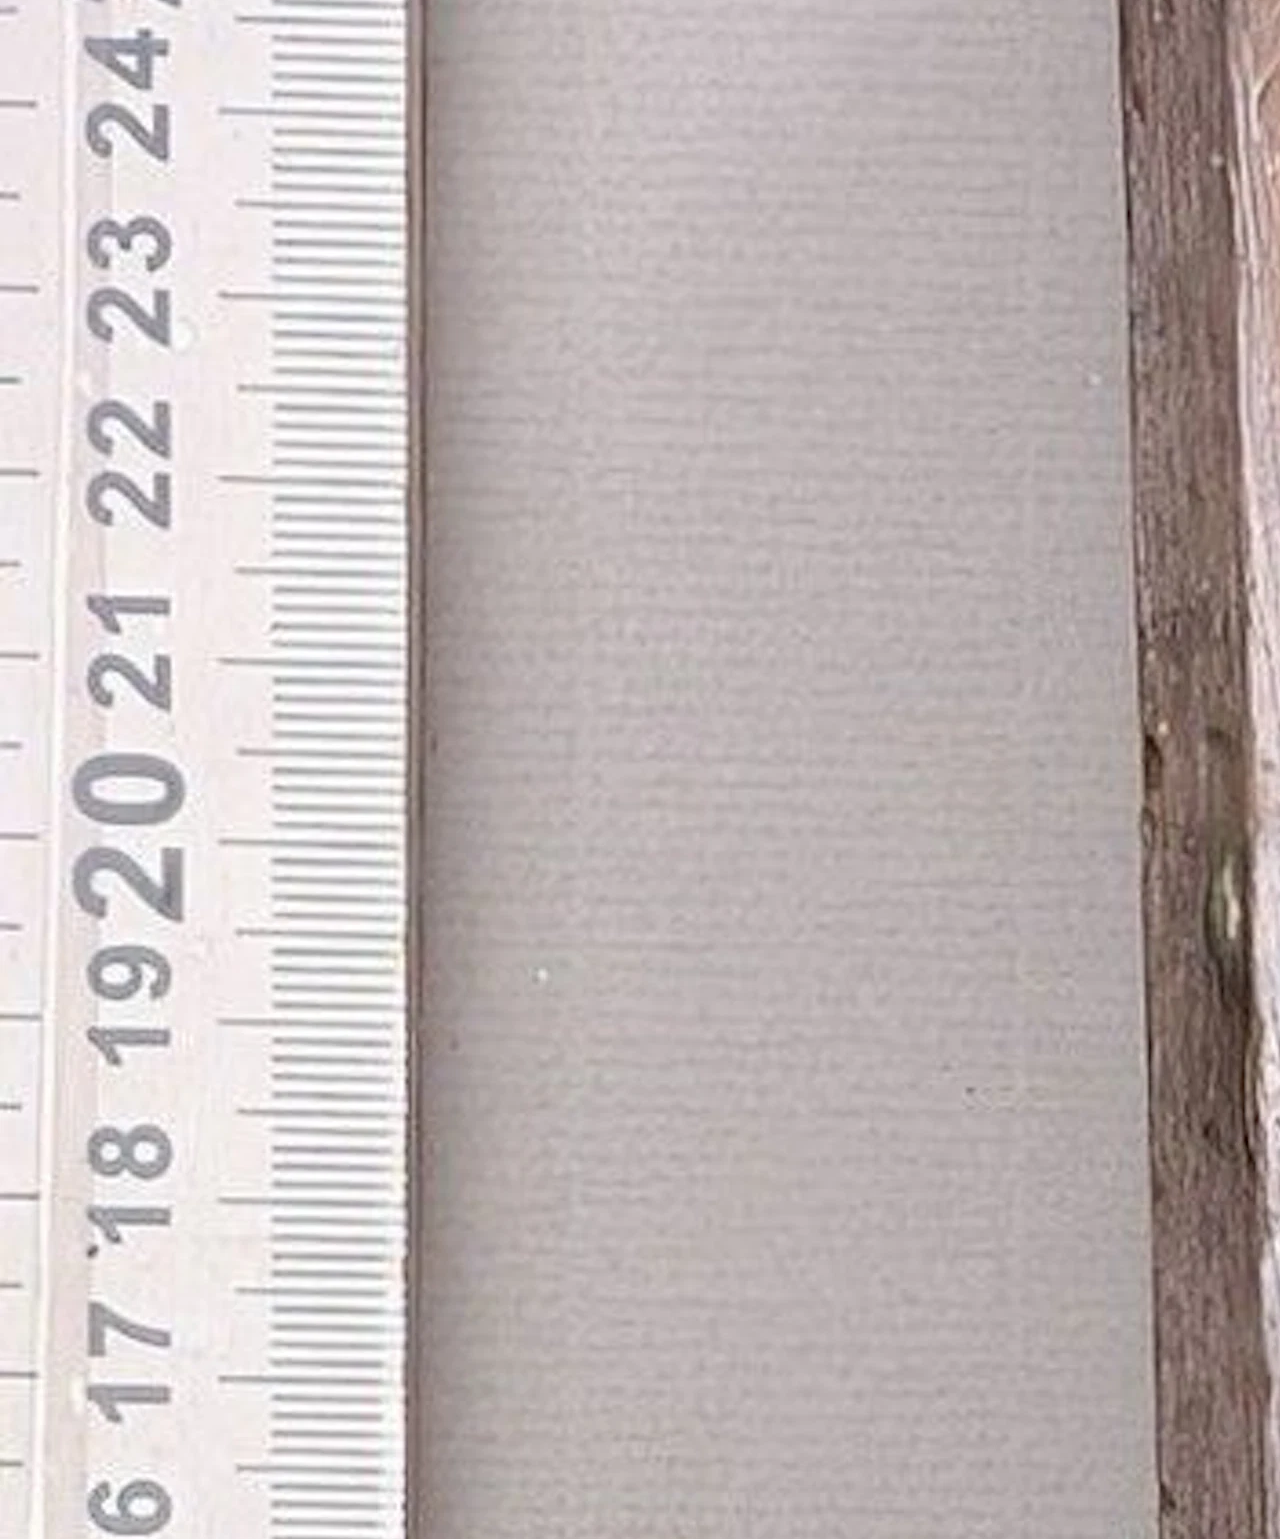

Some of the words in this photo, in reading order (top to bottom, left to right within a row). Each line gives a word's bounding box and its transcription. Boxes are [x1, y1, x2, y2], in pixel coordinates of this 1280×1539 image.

[84, 30, 170, 162] 24
[87, 217, 172, 347] 23
[86, 400, 171, 529] 22
[86, 595, 171, 712] 21
[72, 755, 184, 922] 20
[87, 947, 172, 1066] 19
[86, 1126, 172, 1244] 18
[86, 1302, 171, 1423] 17
